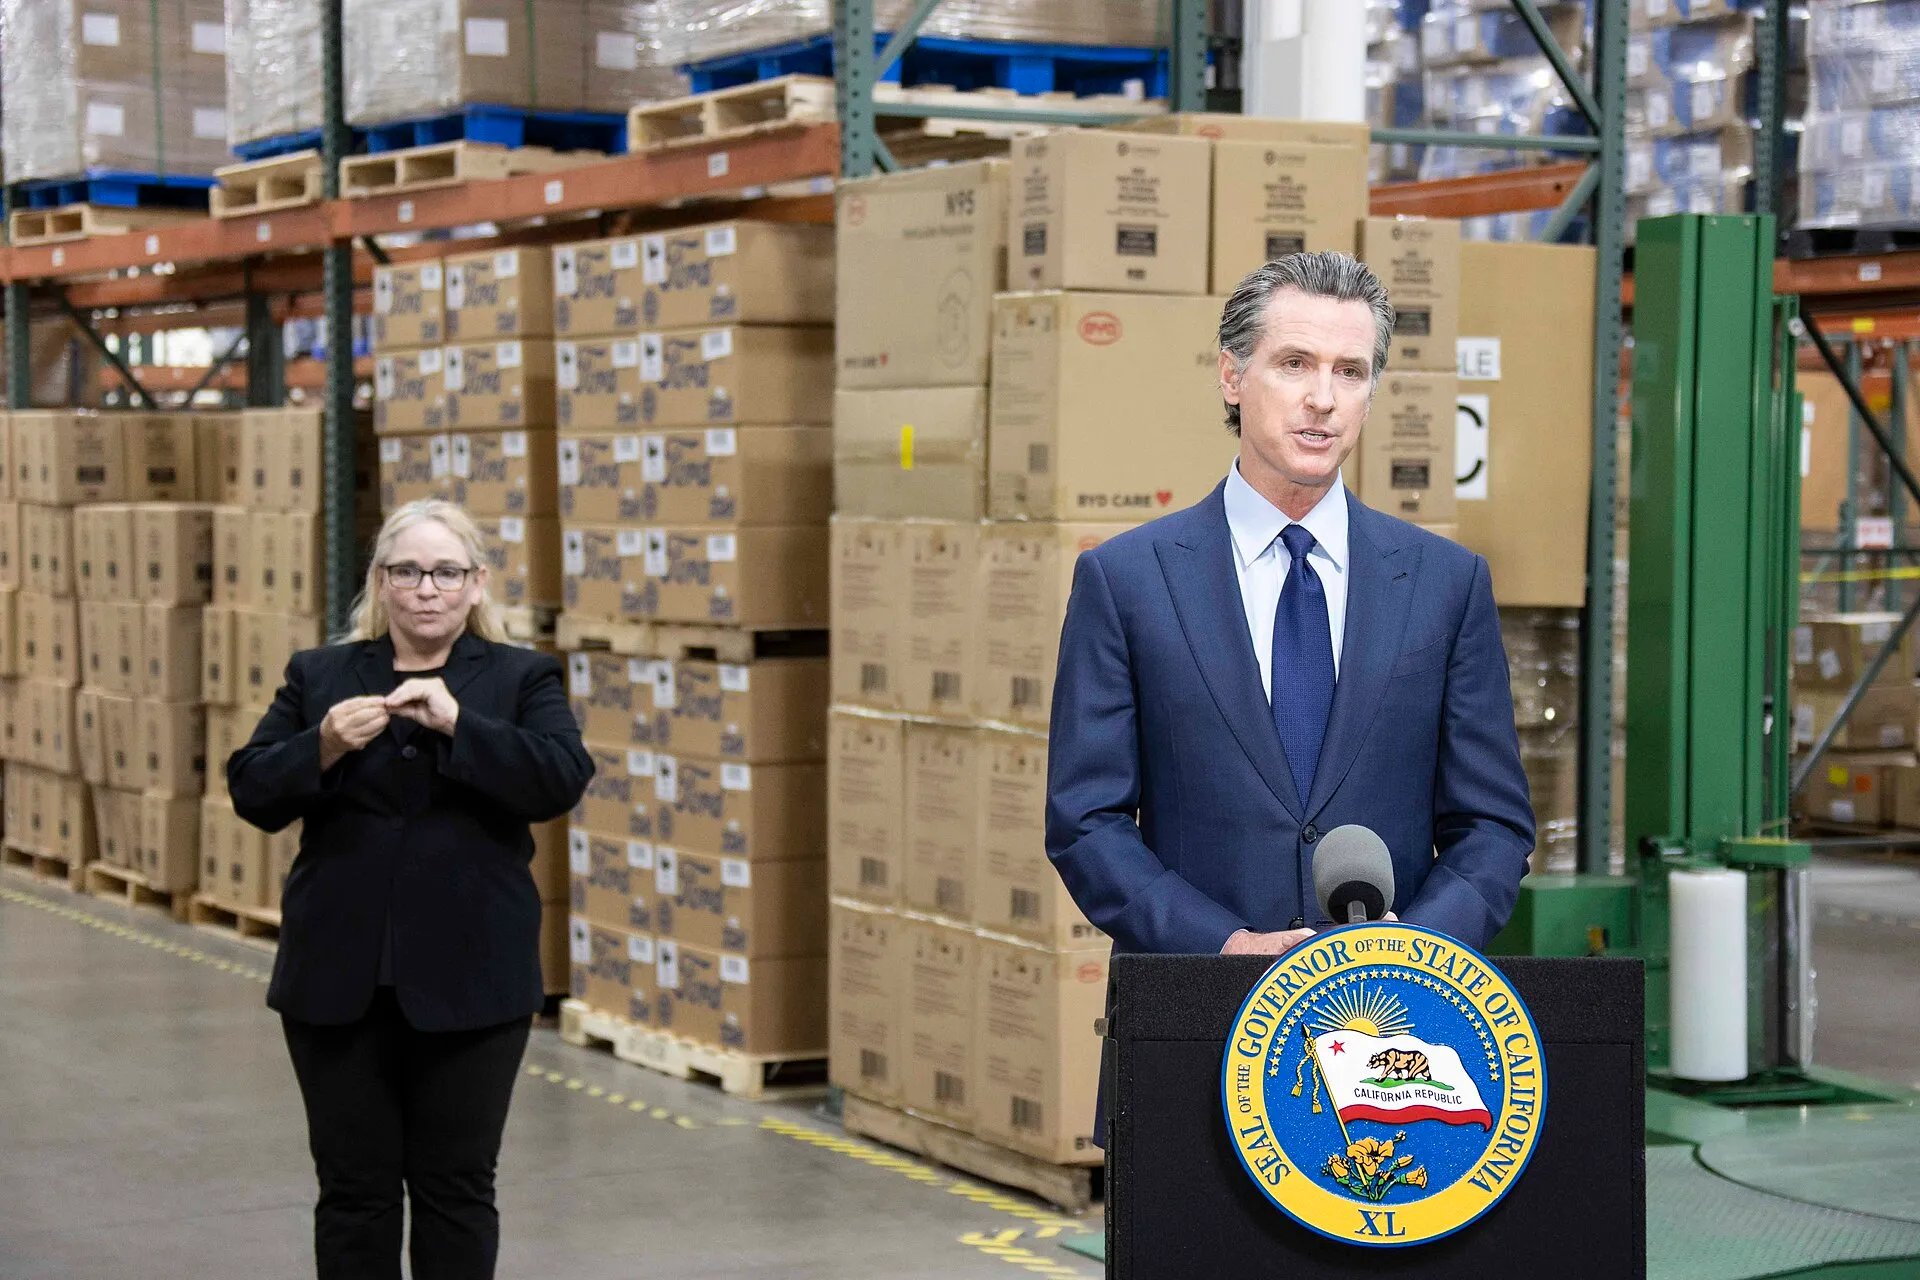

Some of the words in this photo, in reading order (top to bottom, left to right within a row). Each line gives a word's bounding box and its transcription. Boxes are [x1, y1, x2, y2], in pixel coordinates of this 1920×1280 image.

[1112, 493, 1152, 507] CARE
[1355, 939, 1375, 953] OF
[1375, 938, 1406, 953] THE
[1407, 938, 1493, 998] STATE
[1237, 940, 1355, 1059] GOVERNOR
[1484, 992, 1521, 1029] OF
[1237, 1064, 1251, 1092] THE
[1238, 1094, 1252, 1113] OF
[1354, 1087, 1412, 1102] CALIFORNIA
[1414, 1089, 1463, 1105] REPUBLIC
[1467, 1033, 1536, 1194] CALIFORNIA
[1240, 1115, 1291, 1186] SEAL
[1354, 1210, 1406, 1237] XL
